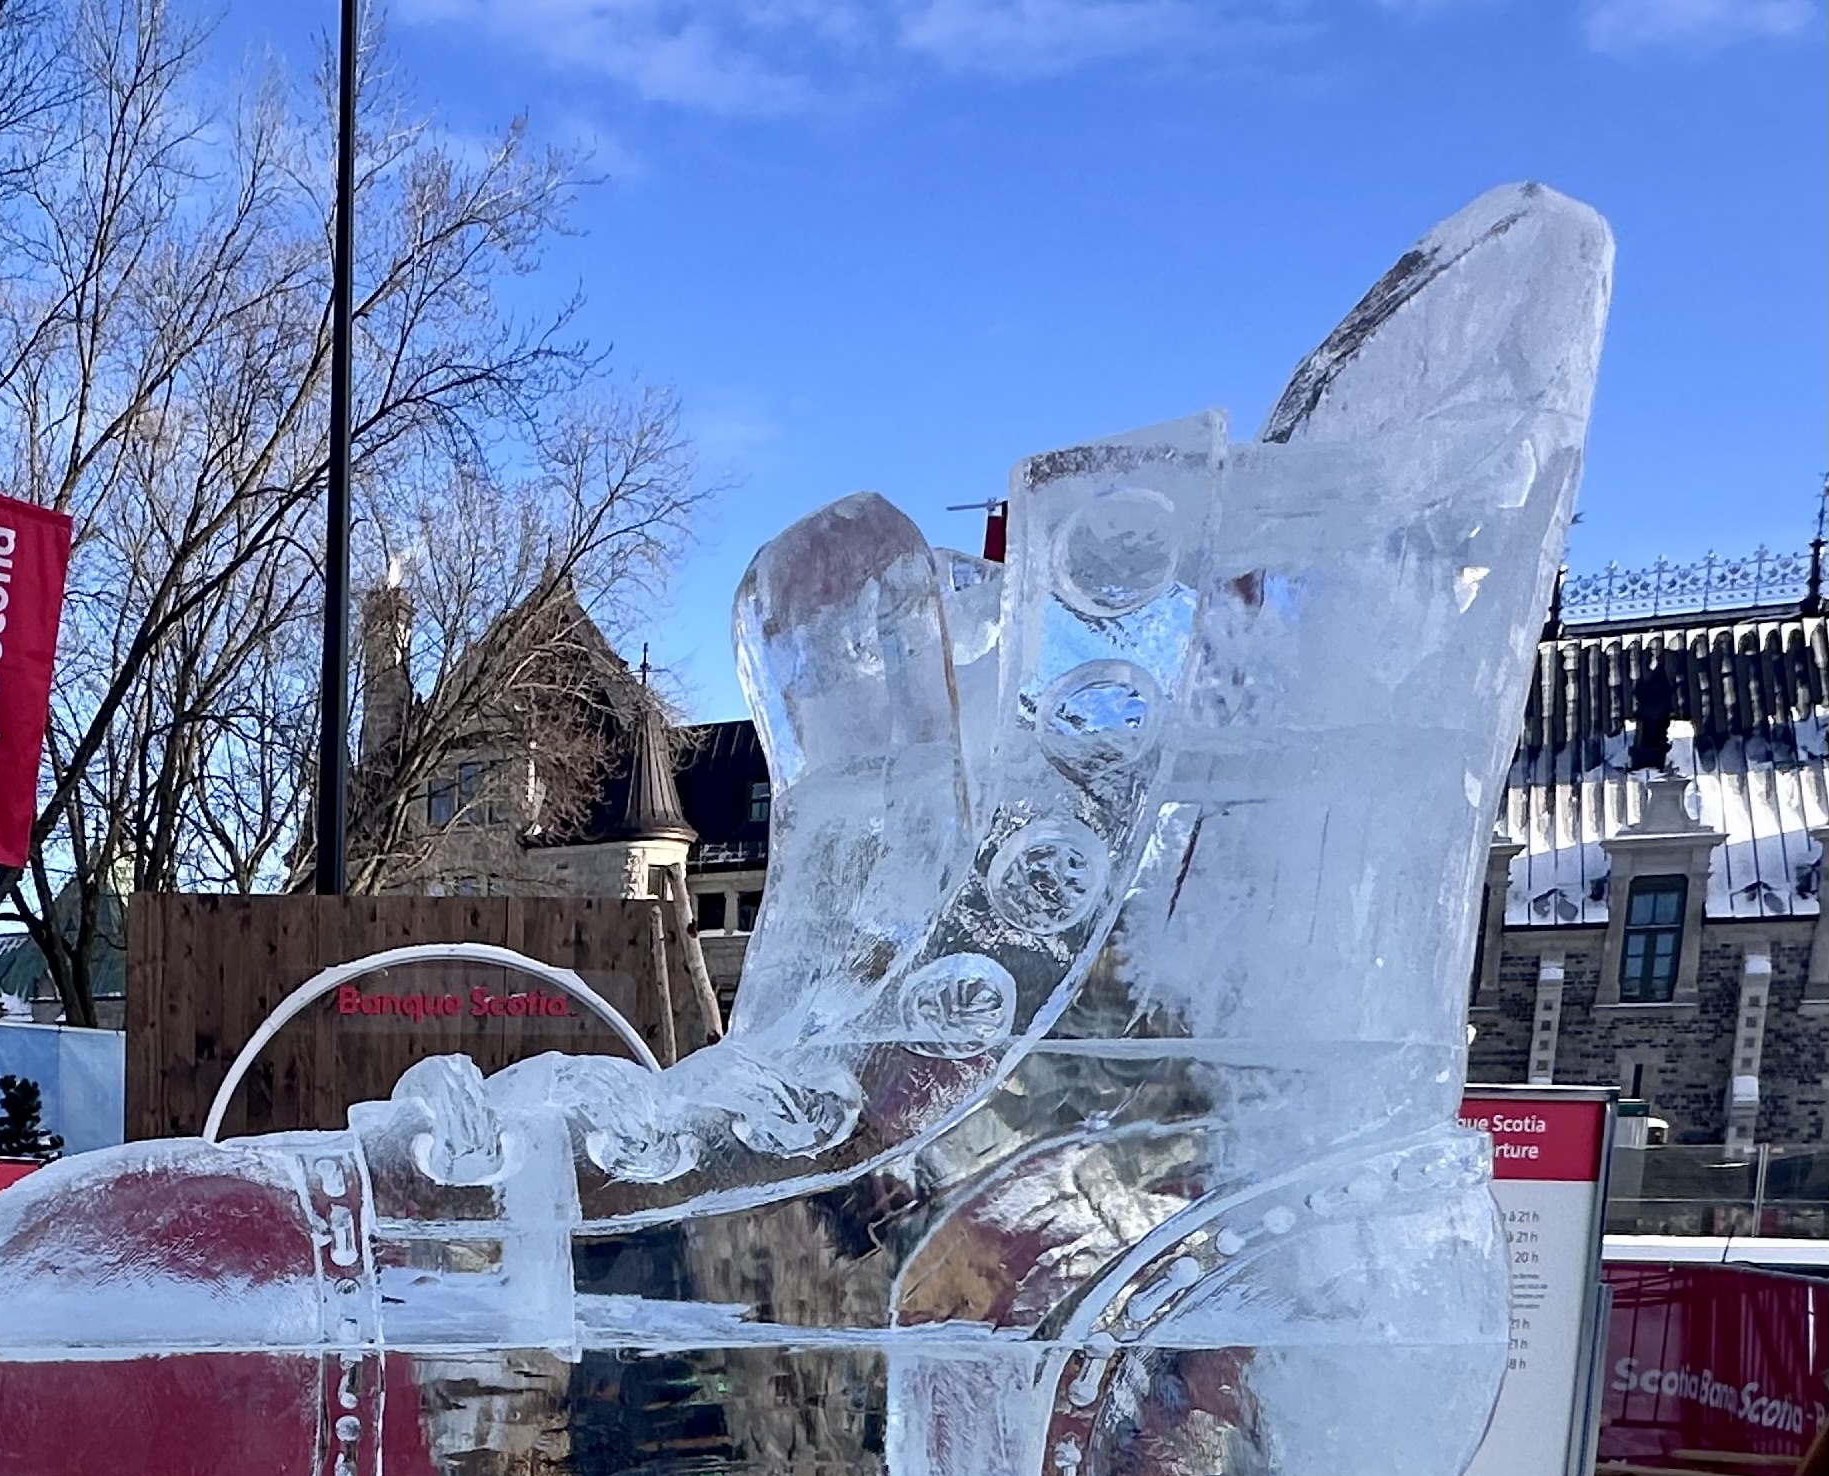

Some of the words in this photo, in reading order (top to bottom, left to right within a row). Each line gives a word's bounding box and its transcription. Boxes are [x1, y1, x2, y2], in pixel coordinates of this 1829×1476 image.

[337, 985, 463, 1024] Banque
[471, 986, 569, 1018] Scotia
[1492, 1114, 1546, 1133] Scotia
[1514, 1250, 1529, 1264] 20
[1531, 1250, 1539, 1263] h
[1611, 1357, 1699, 1400] Scotia
[1738, 1381, 1803, 1435] Scotia
